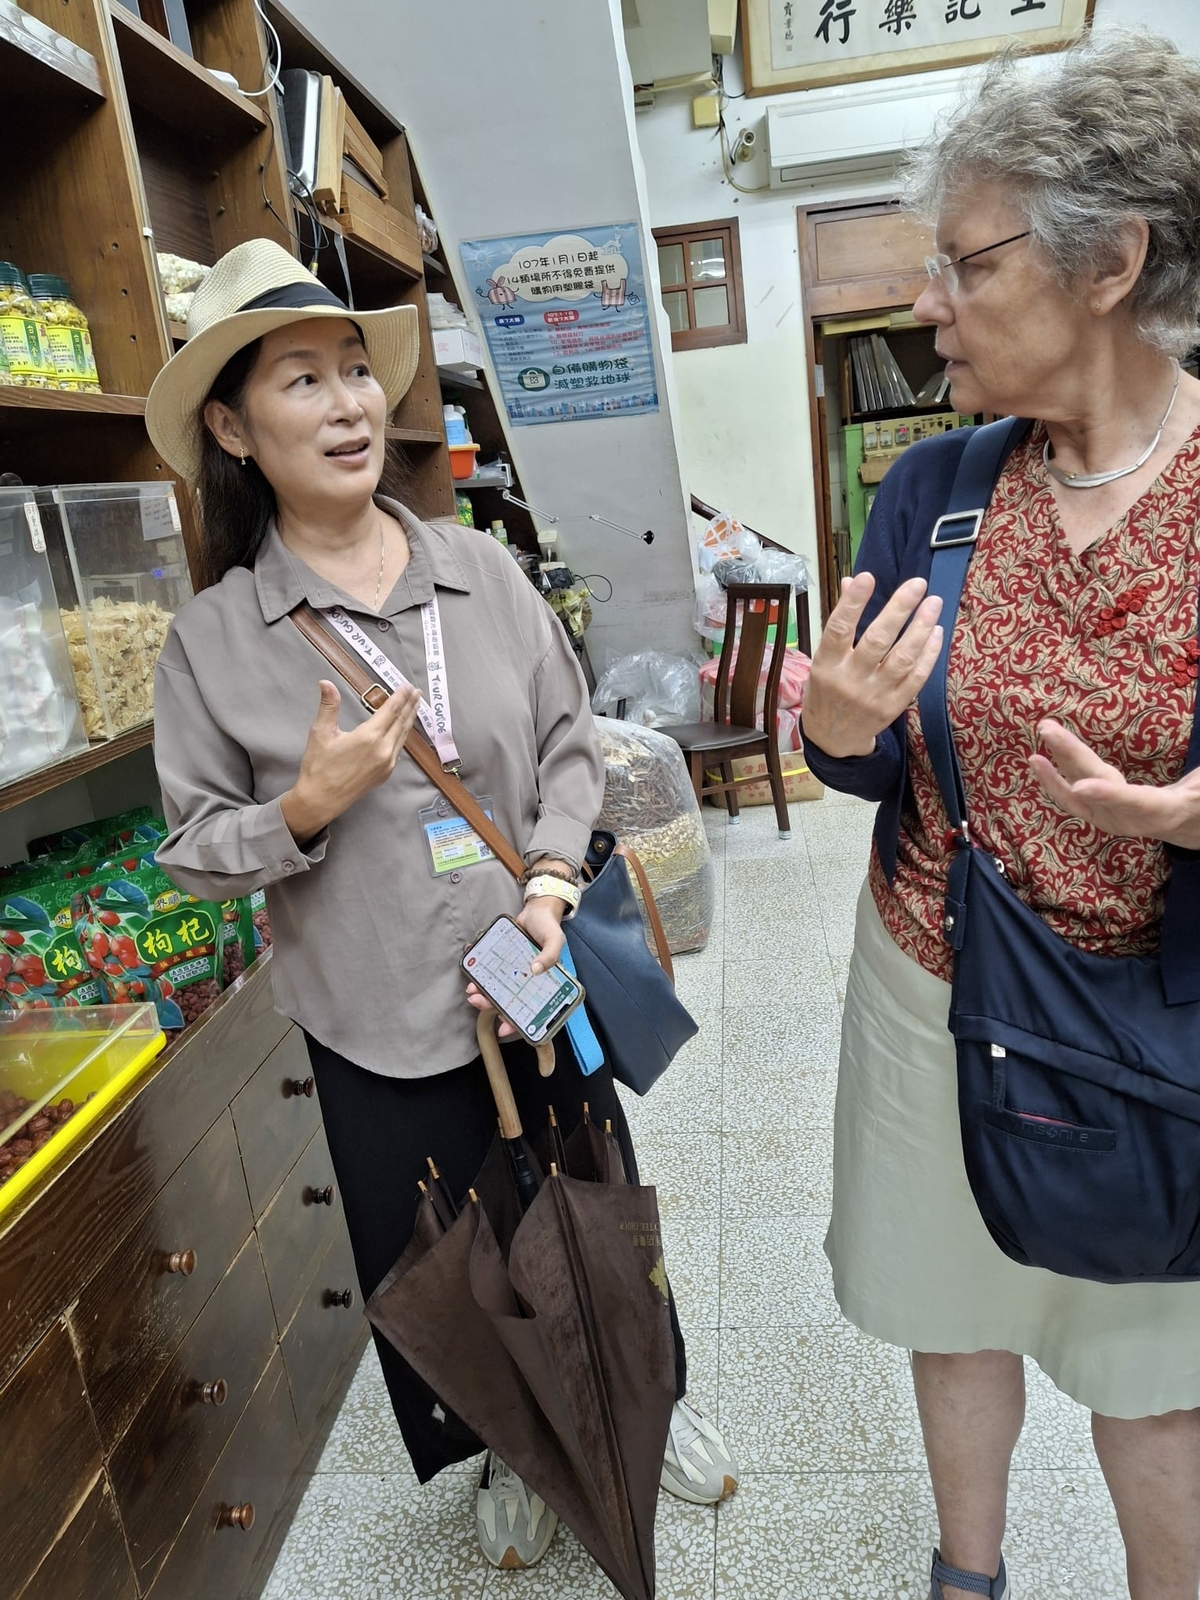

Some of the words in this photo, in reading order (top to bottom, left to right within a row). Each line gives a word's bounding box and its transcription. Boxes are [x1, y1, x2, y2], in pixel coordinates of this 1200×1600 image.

[553, 372, 631, 390] 減塑救地球
[143, 917, 210, 958] 枸杞
